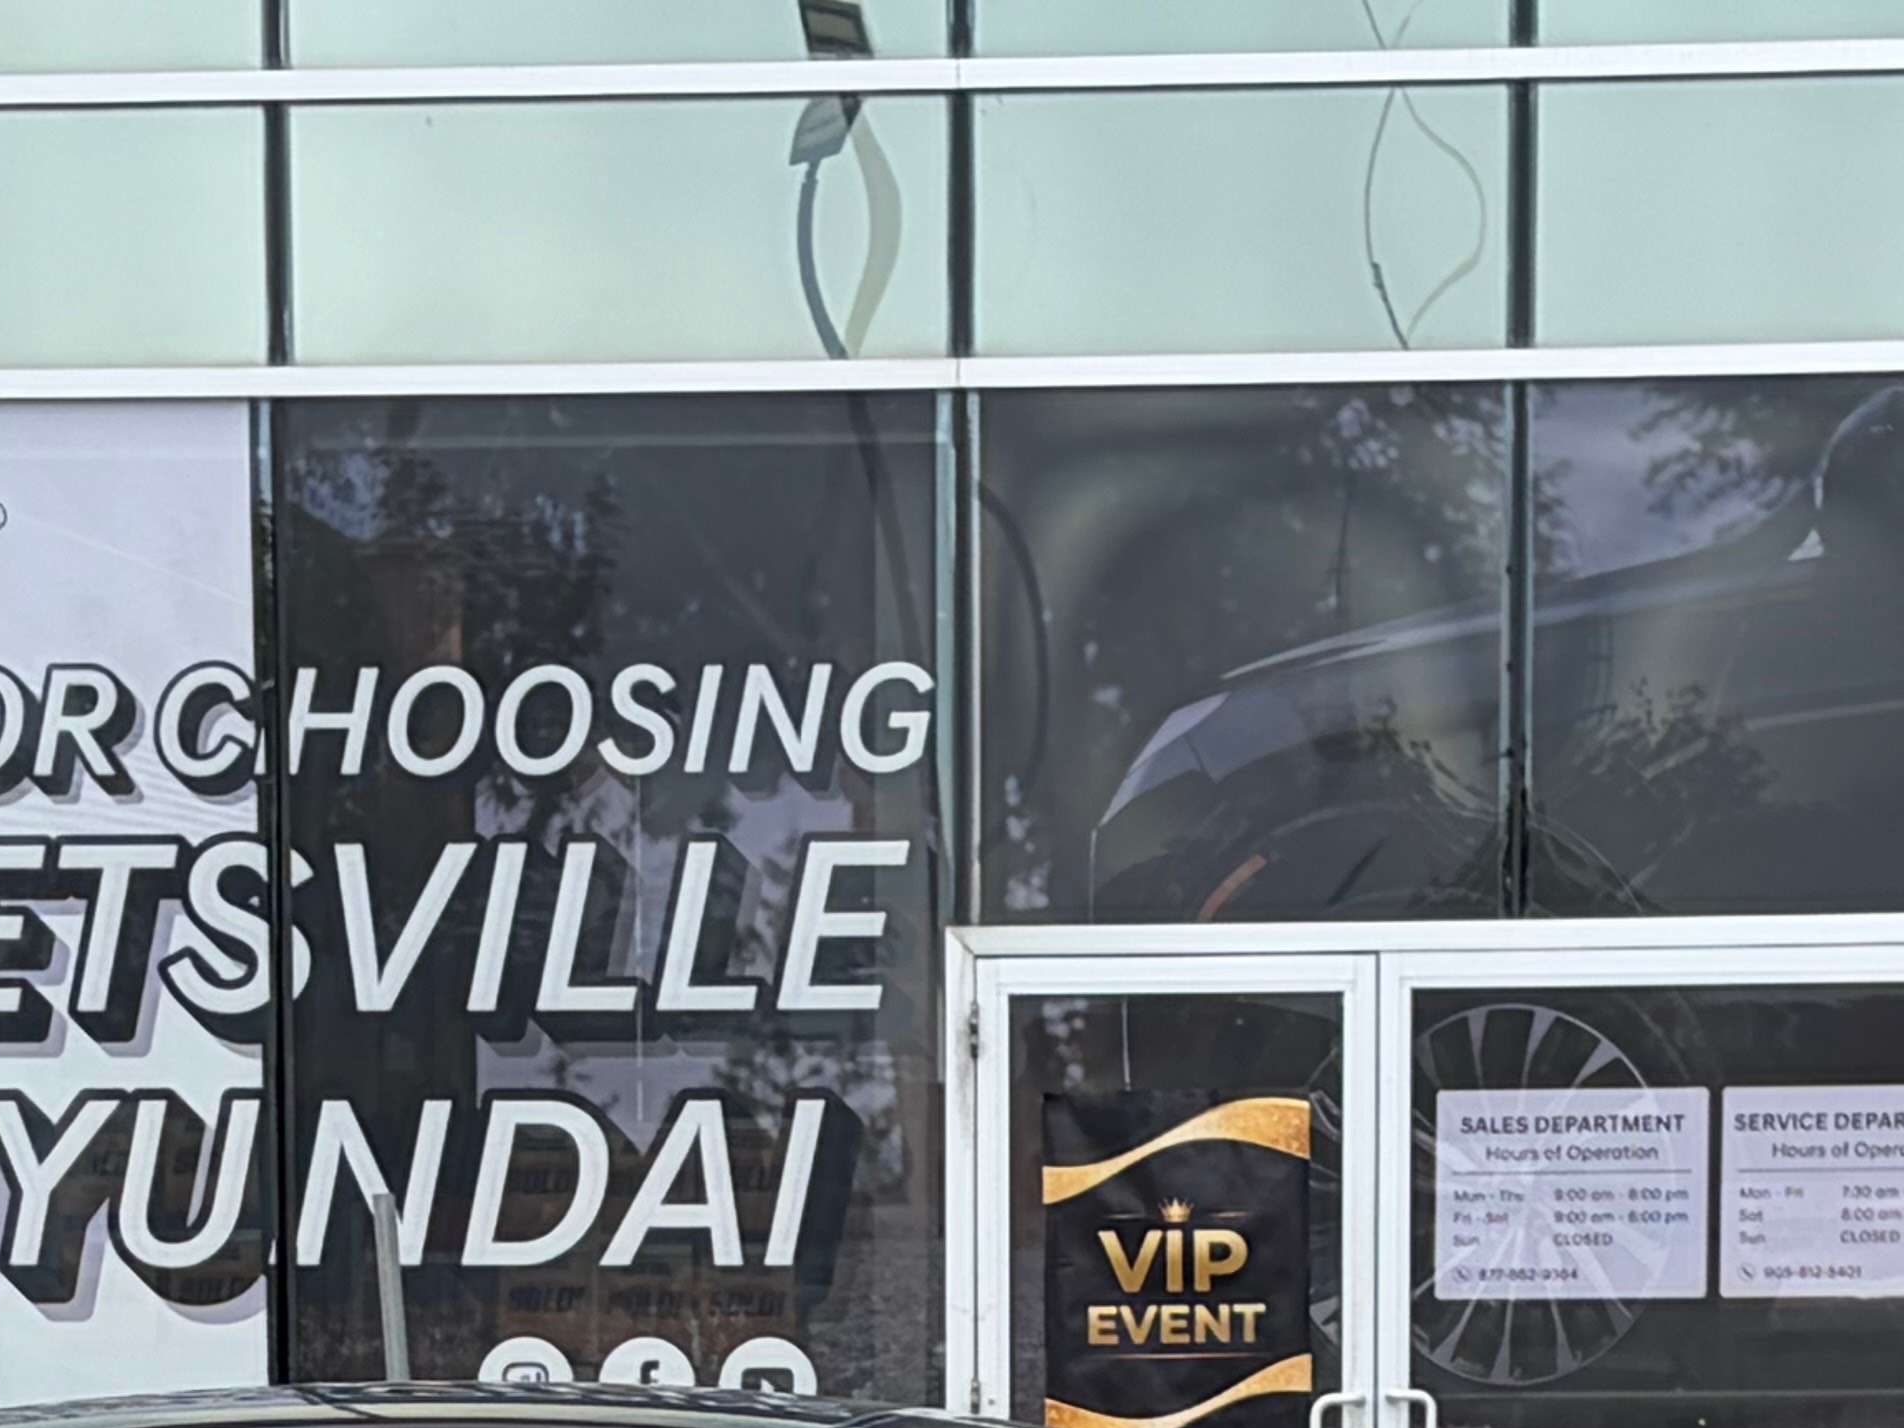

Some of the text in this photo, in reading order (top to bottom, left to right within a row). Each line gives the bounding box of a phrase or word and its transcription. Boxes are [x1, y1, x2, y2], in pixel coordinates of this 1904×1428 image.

[155, 660, 936, 788] CHOOSING
[1460, 1113, 1685, 1135] SALES DEPARTMENT
[1734, 1112, 1828, 1132] SERVICE
[1485, 1144, 1659, 1163] Hours of Operation
[1771, 1142, 1826, 1159] Hours
[1831, 1141, 1850, 1158] of
[1553, 1233, 1613, 1247] CLOSED
[1840, 1230, 1901, 1244] CLOSED
[1098, 1229, 1248, 1294] VIP
[1087, 1303, 1268, 1346] EVENT
